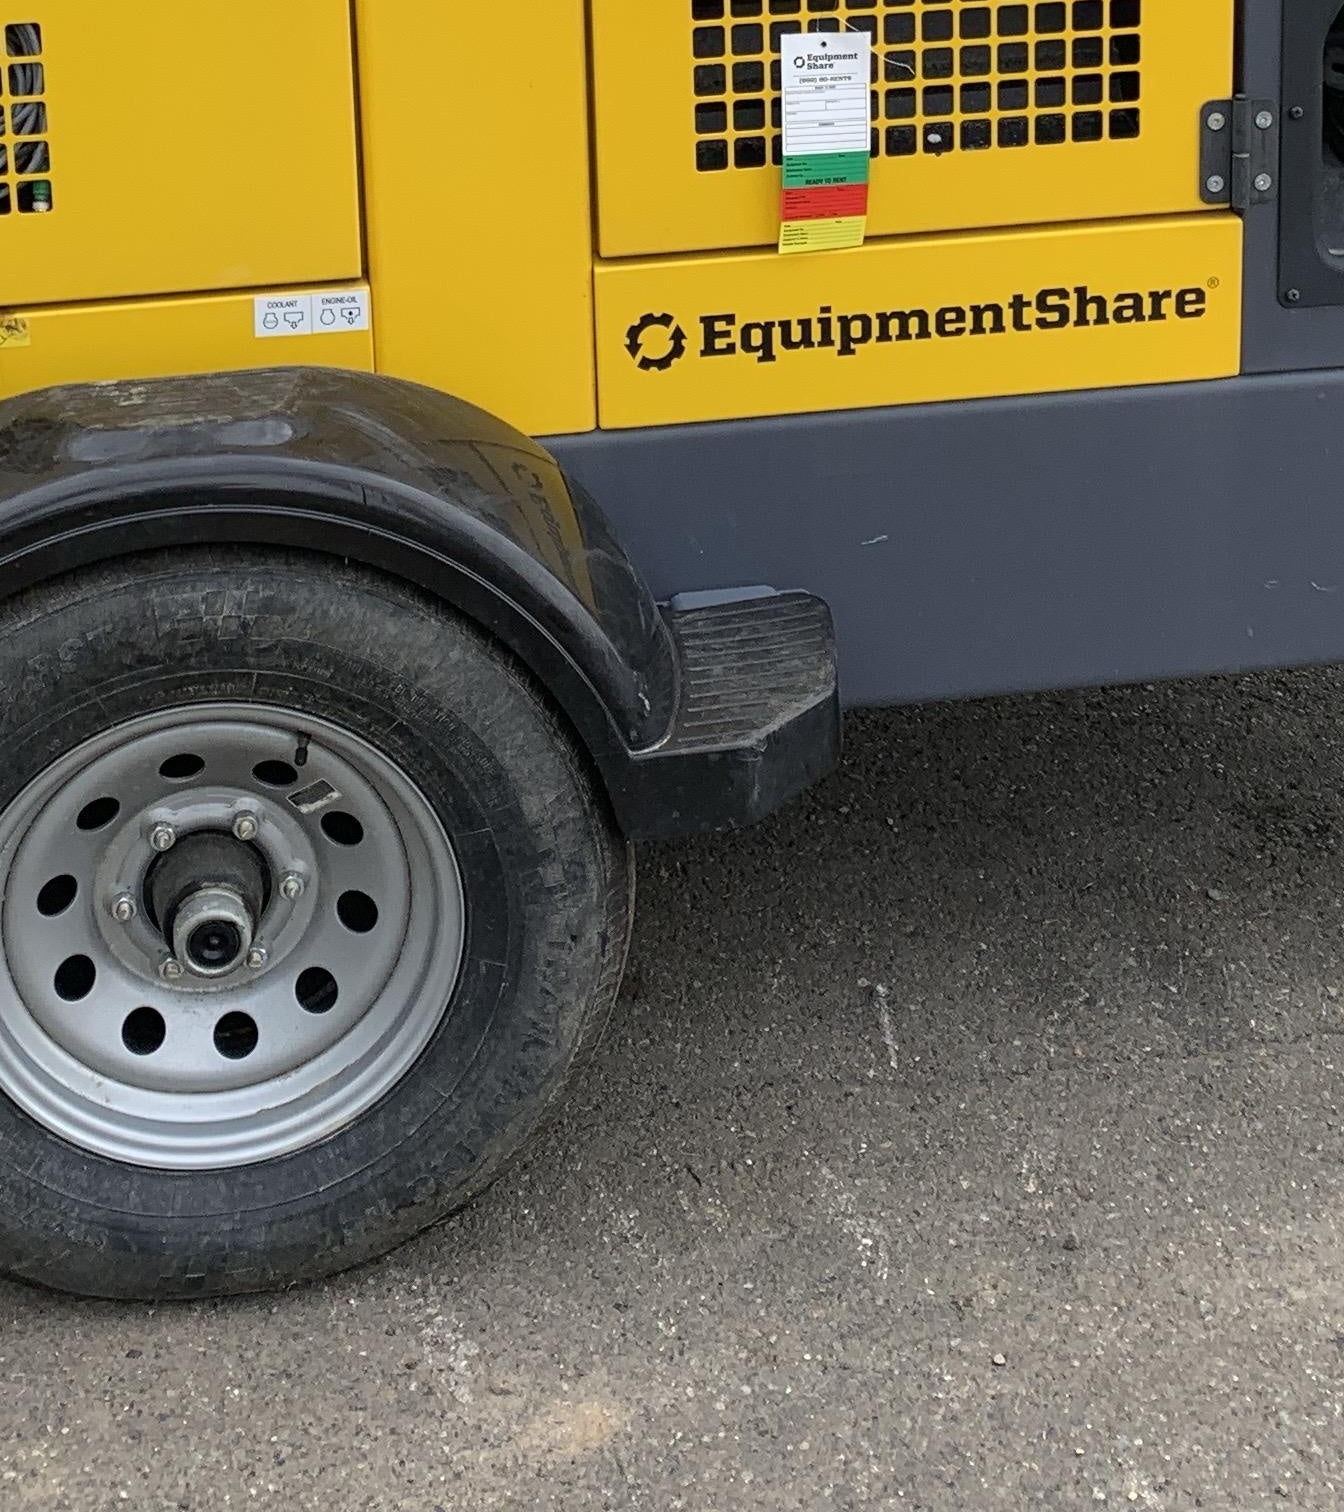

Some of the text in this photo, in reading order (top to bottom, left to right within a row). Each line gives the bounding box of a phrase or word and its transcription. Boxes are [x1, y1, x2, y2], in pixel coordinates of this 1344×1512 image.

[807, 53, 858, 62] Equipment
[267, 296, 358, 308] COOLANT ENGINE-OIL
[699, 286, 1206, 362] EquipmentShare
